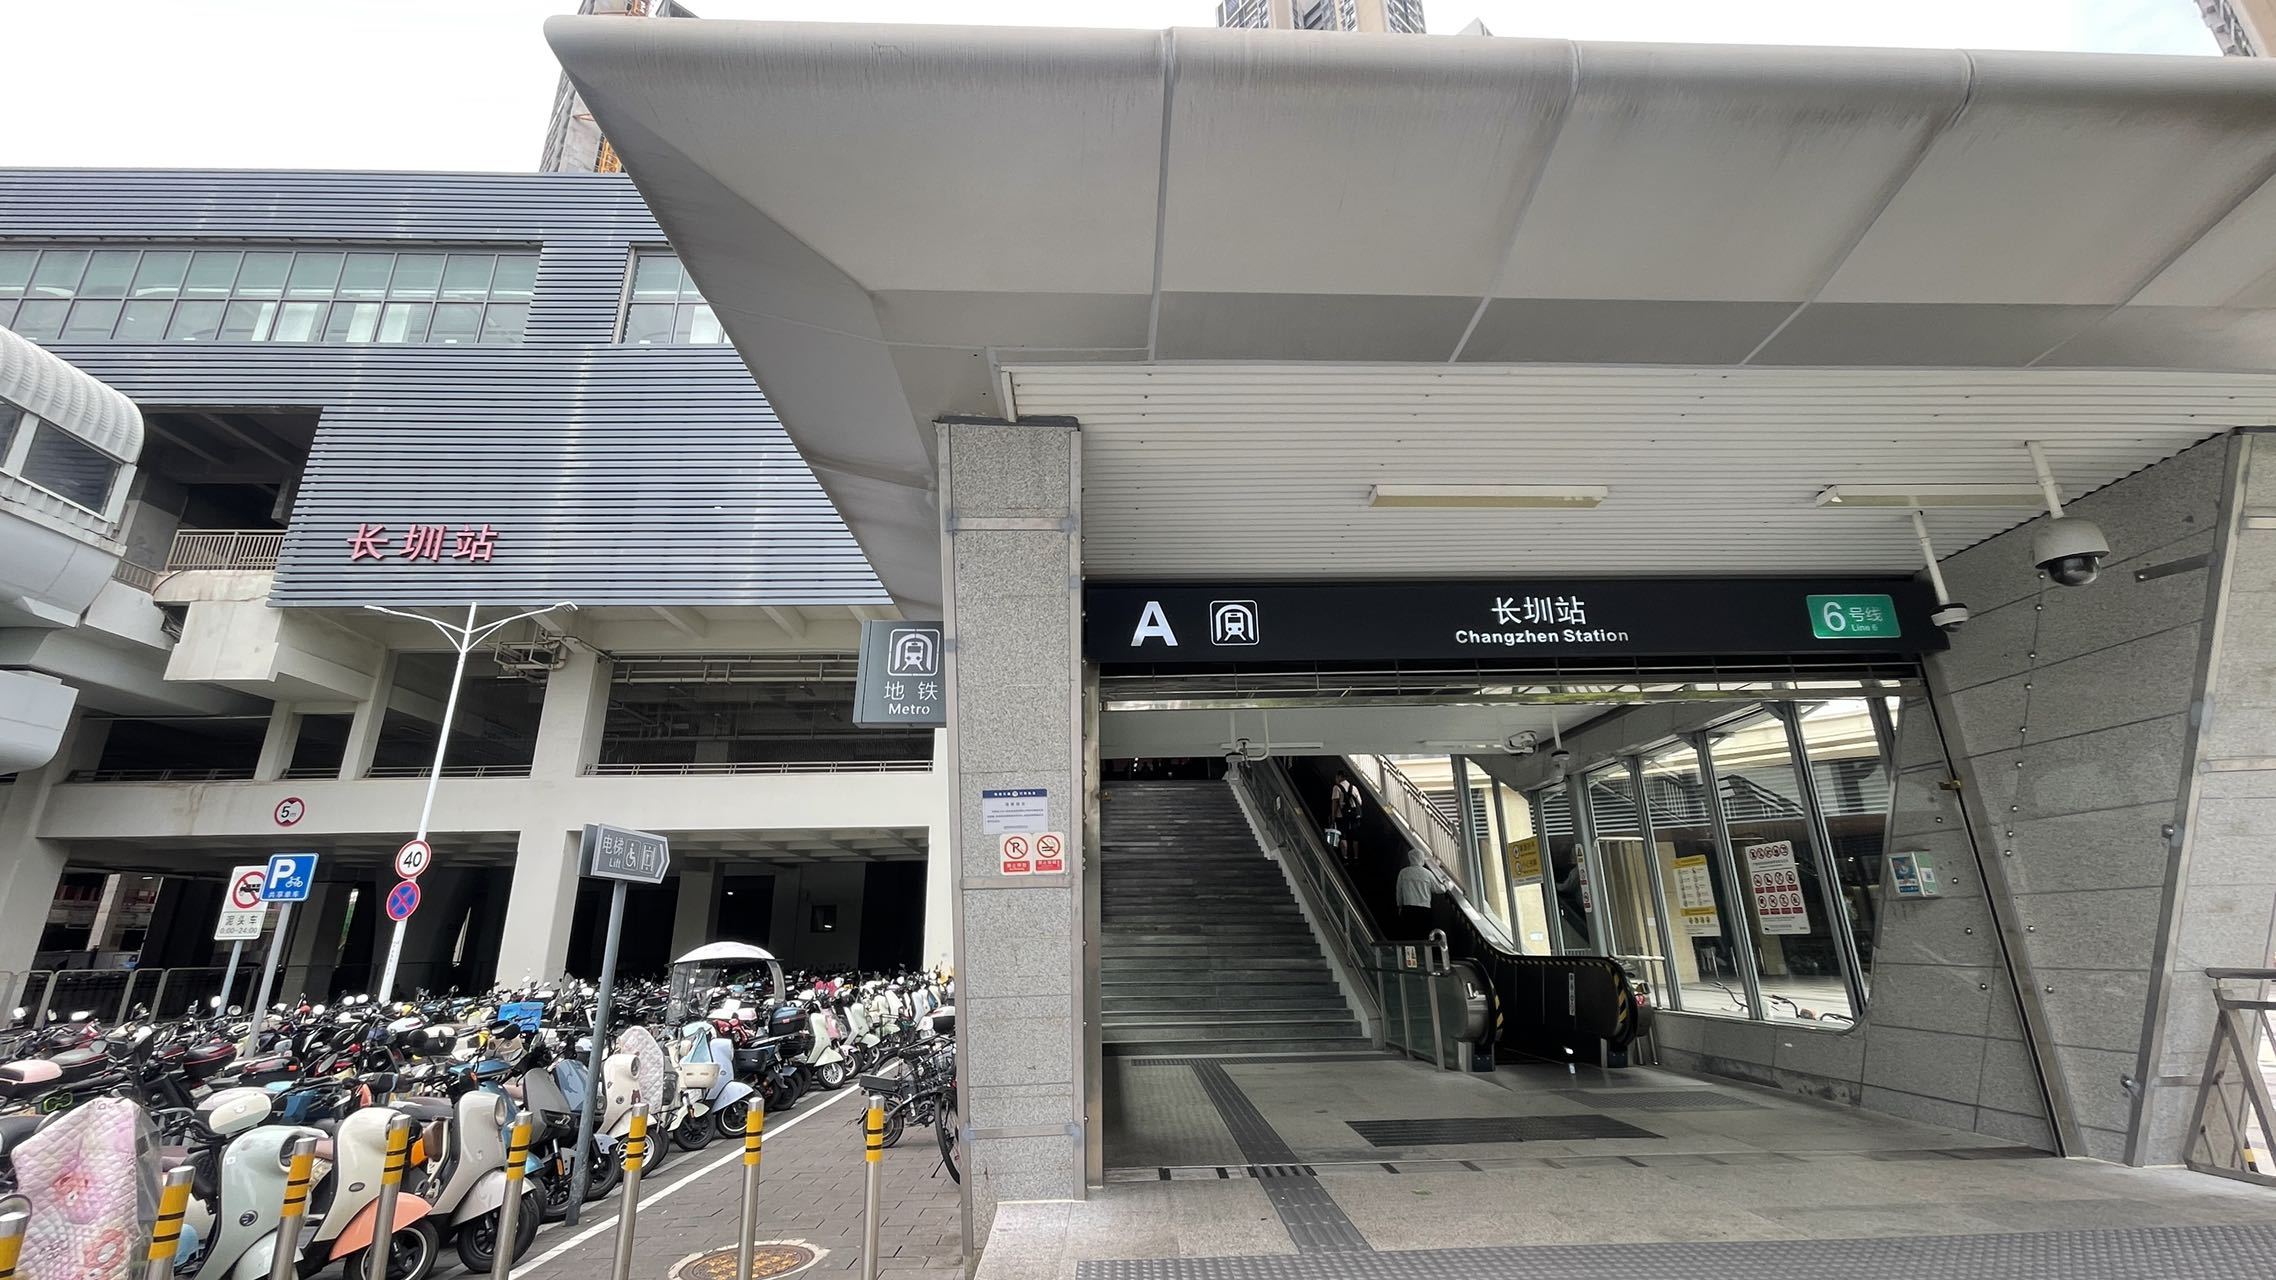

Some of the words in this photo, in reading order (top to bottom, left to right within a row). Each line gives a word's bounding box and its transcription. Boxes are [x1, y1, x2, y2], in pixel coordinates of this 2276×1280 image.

[347, 523, 499, 562] 长圳站
[1491, 596, 1586, 625] 长圳站
[1131, 601, 1178, 646] A
[1851, 624, 1871, 632] Line
[1456, 630, 1559, 646] Changzhen
[1563, 629, 1629, 643] Station
[883, 681, 938, 701] 地铁
[889, 703, 930, 715] Metro
[602, 835, 624, 855] 电梯
[404, 851, 422, 868] 40
[609, 858, 620, 869] Lift
[269, 859, 297, 889] P
[268, 890, 300, 898] 共享单车
[225, 915, 258, 926] 泥头车
